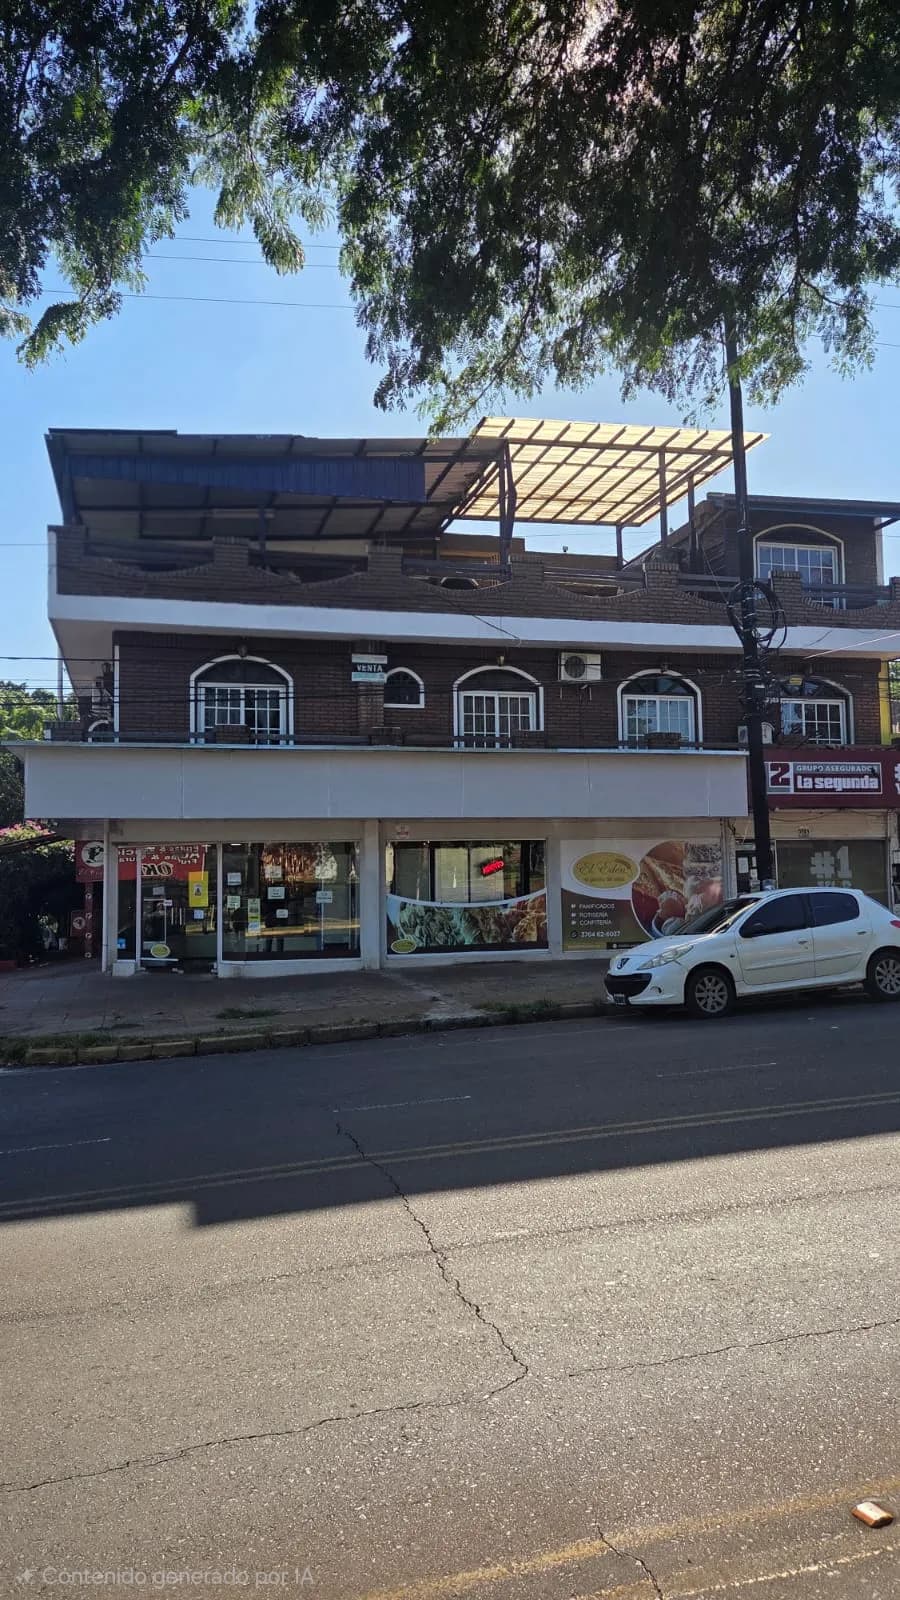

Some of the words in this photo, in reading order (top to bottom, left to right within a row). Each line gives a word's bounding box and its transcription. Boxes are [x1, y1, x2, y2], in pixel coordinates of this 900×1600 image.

[356, 664, 383, 672] VENTA
[796, 764, 824, 772] GRUPO
[814, 775, 879, 791] segunda
[809, 846, 853, 879] #1
